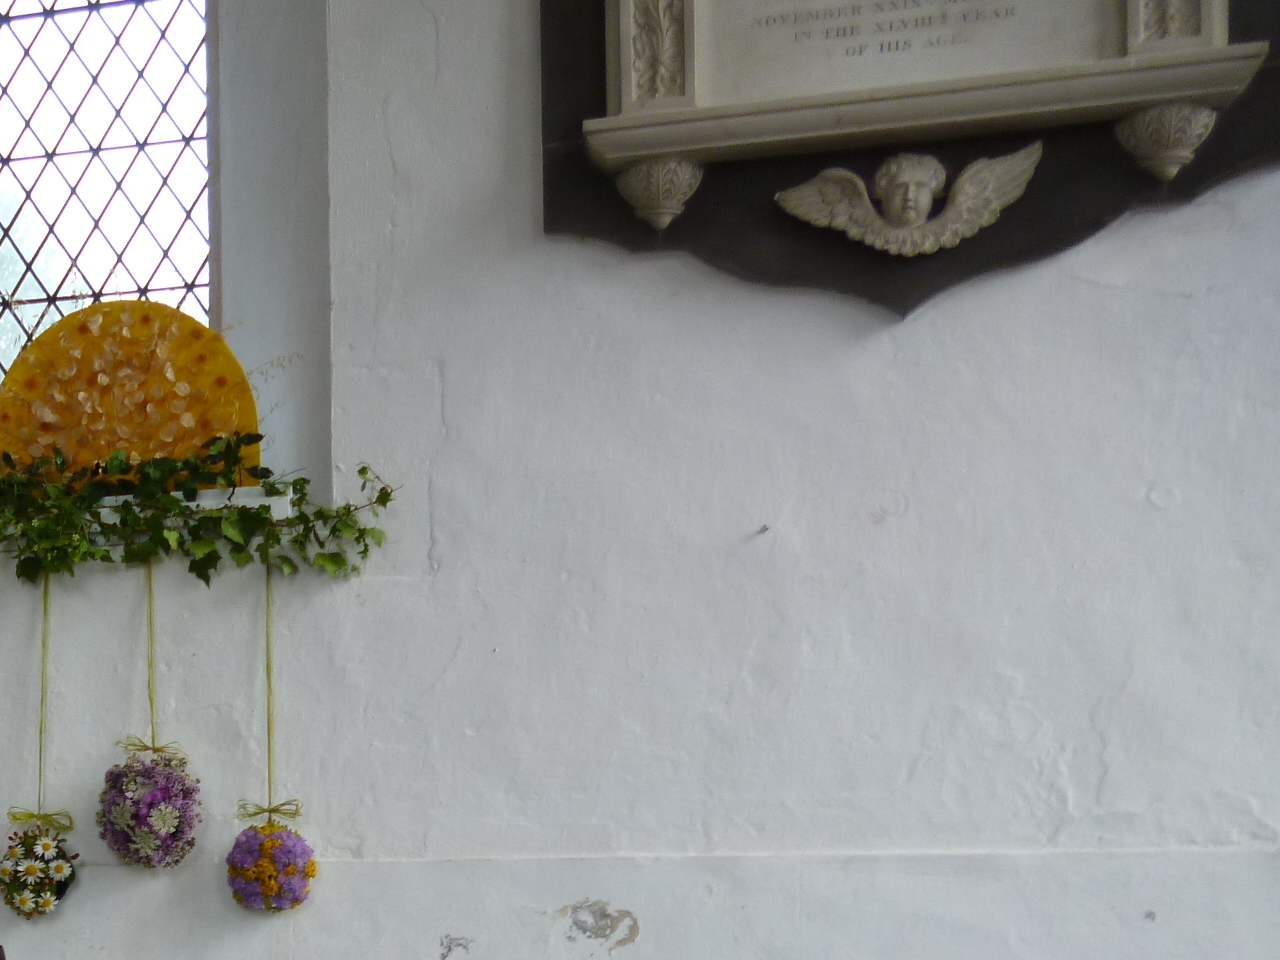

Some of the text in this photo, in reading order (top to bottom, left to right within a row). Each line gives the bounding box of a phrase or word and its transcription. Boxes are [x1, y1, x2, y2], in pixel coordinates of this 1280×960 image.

[750, 5, 862, 27] NOVEMBER
[793, 31, 812, 42] IN
[822, 25, 861, 39] THE
[962, 5, 1016, 21] YEAR
[844, 43, 869, 56] OF
[879, 39, 912, 54] HIS
